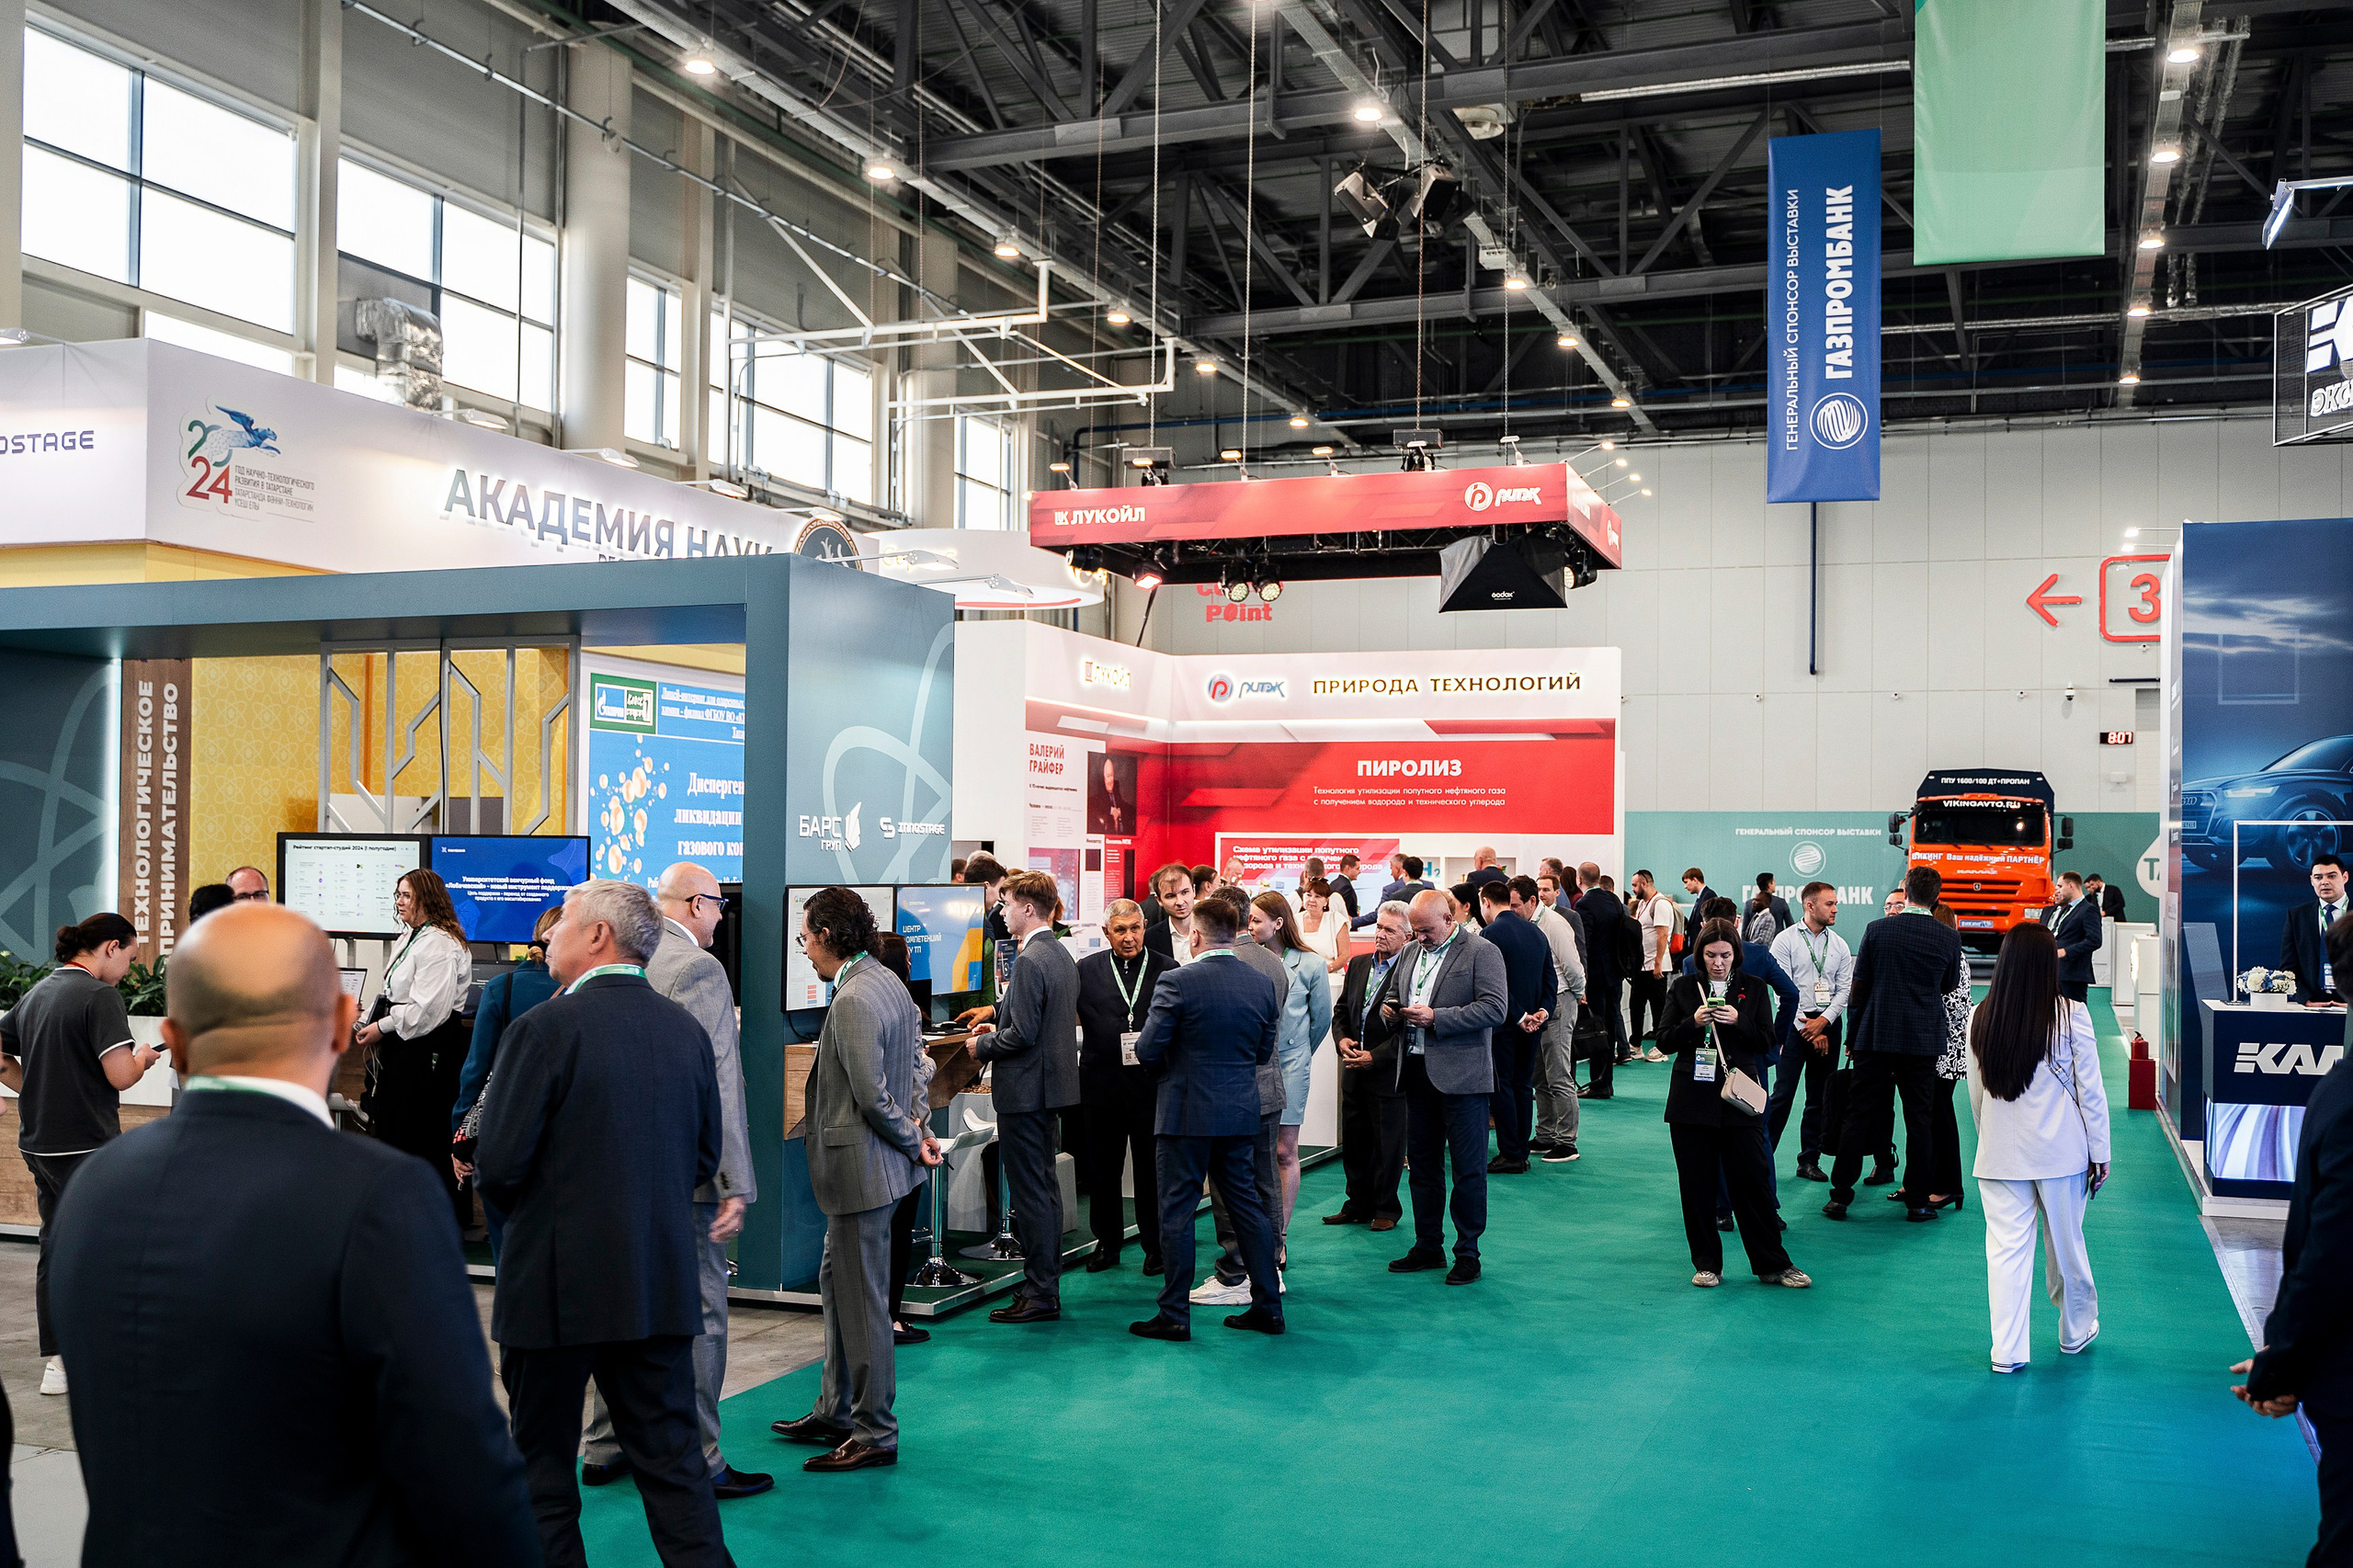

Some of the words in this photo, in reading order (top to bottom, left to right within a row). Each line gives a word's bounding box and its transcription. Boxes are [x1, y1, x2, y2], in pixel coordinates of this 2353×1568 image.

[1787, 188, 1799, 267] ВЫСТАВКИ
[1825, 185, 1853, 380] ГАЗПРОМБАНК
[1786, 270, 1799, 345] СПОНСОР
[1783, 347, 1799, 451] ГЕНЕРАЛЬНЫЙ
[444, 469, 675, 559] АКАДЕМИЯ
[1071, 505, 1145, 525] ЛУКОЙЛ
[2128, 573, 2160, 623] 3
[1313, 679, 1419, 695] ПРИРОДА
[1430, 672, 1581, 692] ТЕХНОЛОГИЙ
[1029, 743, 1064, 759] ВАЛЕРИЙ
[1029, 759, 1063, 775] ГРАЙФЕР
[1357, 759, 1462, 777] ПИРОЛИЗ
[1313, 787, 1356, 795] Технология
[1358, 788, 1401, 796] утилизации
[1403, 788, 1442, 796] попутного
[1445, 787, 1486, 796] нефтяного
[1321, 799, 1366, 807] получением
[1368, 799, 1405, 807] водорода
[1943, 800, 2021, 809] VIKINGAVTO.RU
[134, 680, 154, 948] ТЕХНОЛОГИЧЕСКОЕ
[674, 809, 743, 827] ликвидации
[799, 815, 842, 838] БАРС
[1735, 827, 1793, 836] ГЕНЕРАЛЬНЫЙ
[1794, 828, 1835, 836] СПОНСОР
[1836, 828, 1881, 836] ВЫСТАВКИ
[677, 841, 724, 857] газового
[821, 839, 842, 851] ГРУП
[2006, 853, 2046, 865] ПАРТНЁР
[905, 932, 942, 943] ОМПЕТЕНЦИЙ
